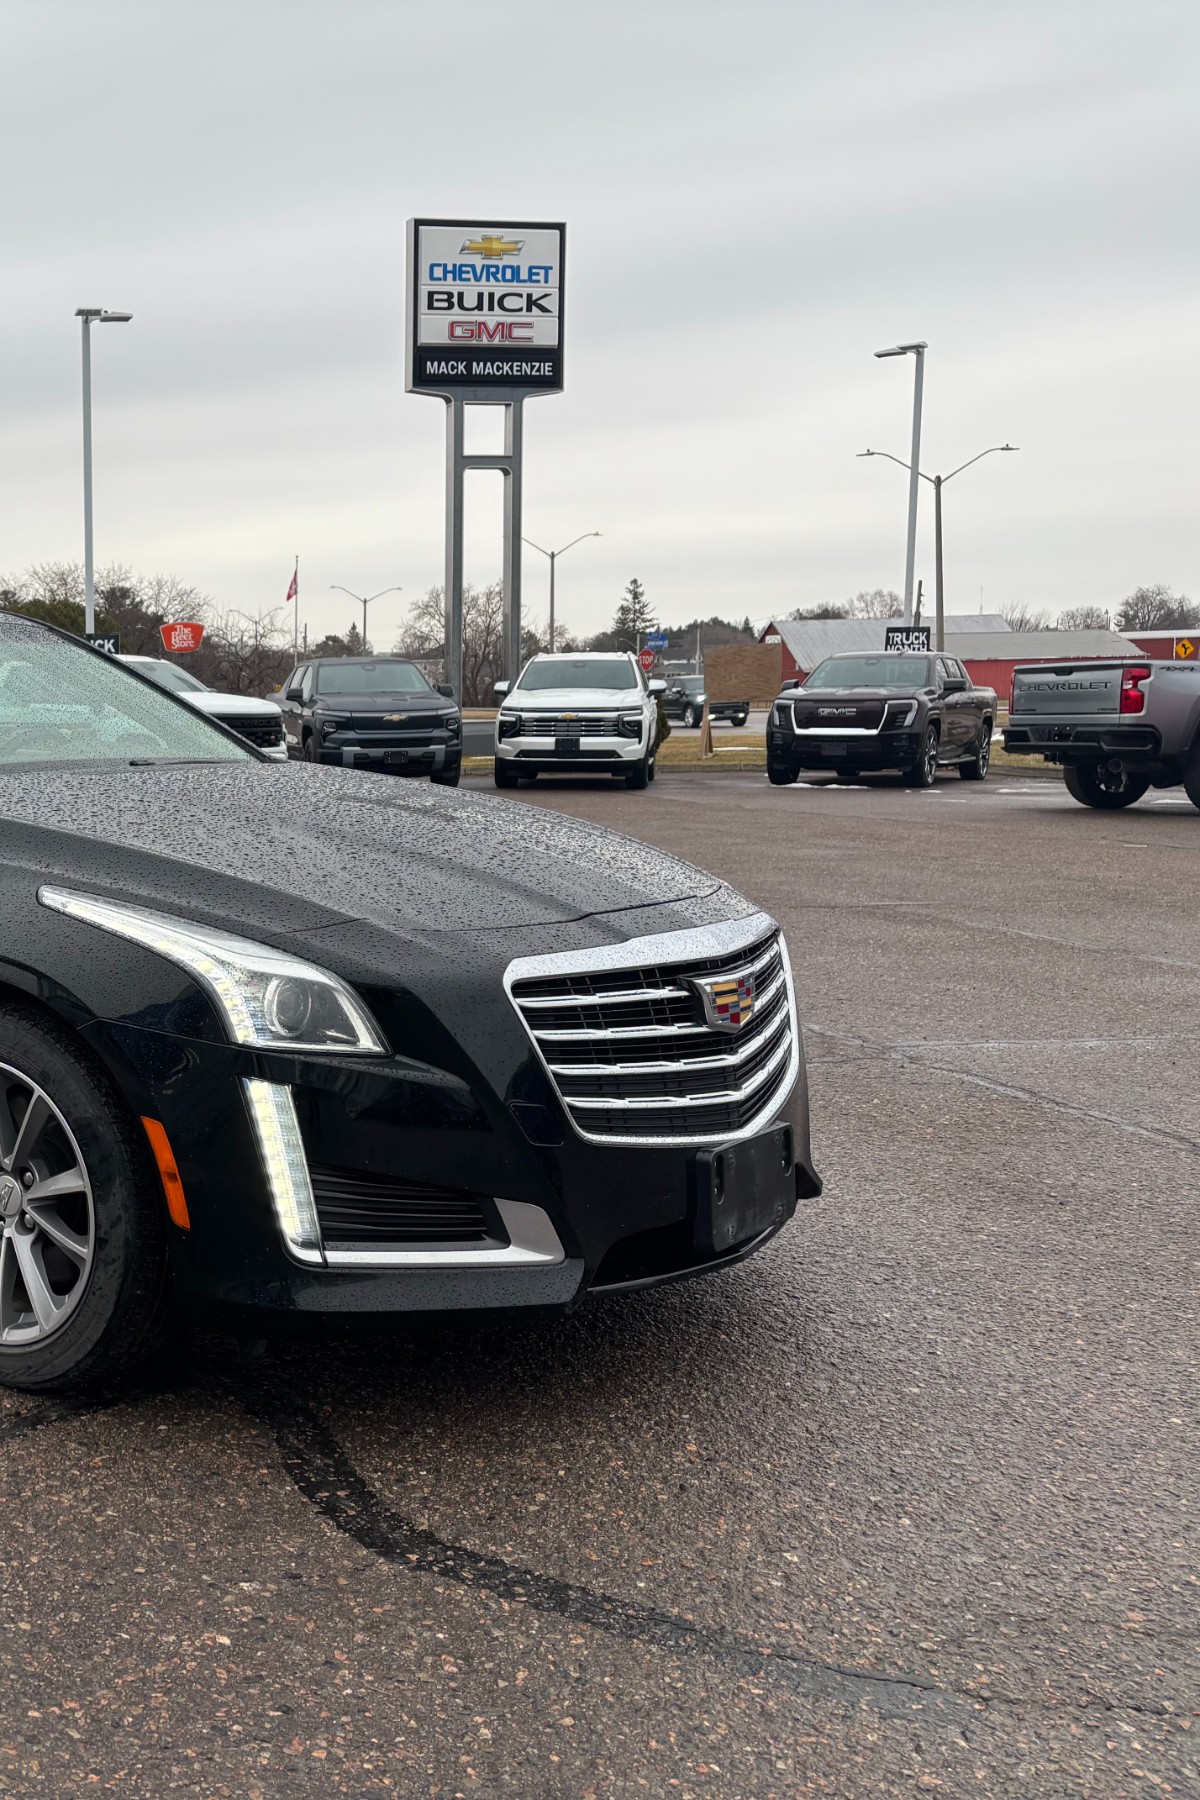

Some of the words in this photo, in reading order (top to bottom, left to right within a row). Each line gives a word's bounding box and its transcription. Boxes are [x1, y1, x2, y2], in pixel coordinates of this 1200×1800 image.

[428, 263, 553, 284] CHEVROLET
[427, 291, 553, 313] BUICK
[448, 320, 534, 343] GMC
[426, 361, 467, 375] MACK
[472, 361, 553, 376] MACKENZIE
[174, 624, 192, 634] The
[171, 631, 193, 641] Beer
[888, 631, 927, 645] TRUCK
[171, 640, 195, 649] Store
[639, 655, 654, 665] STOP
[1019, 681, 1112, 692] CHEVROLET
[818, 707, 857, 717] GMC
